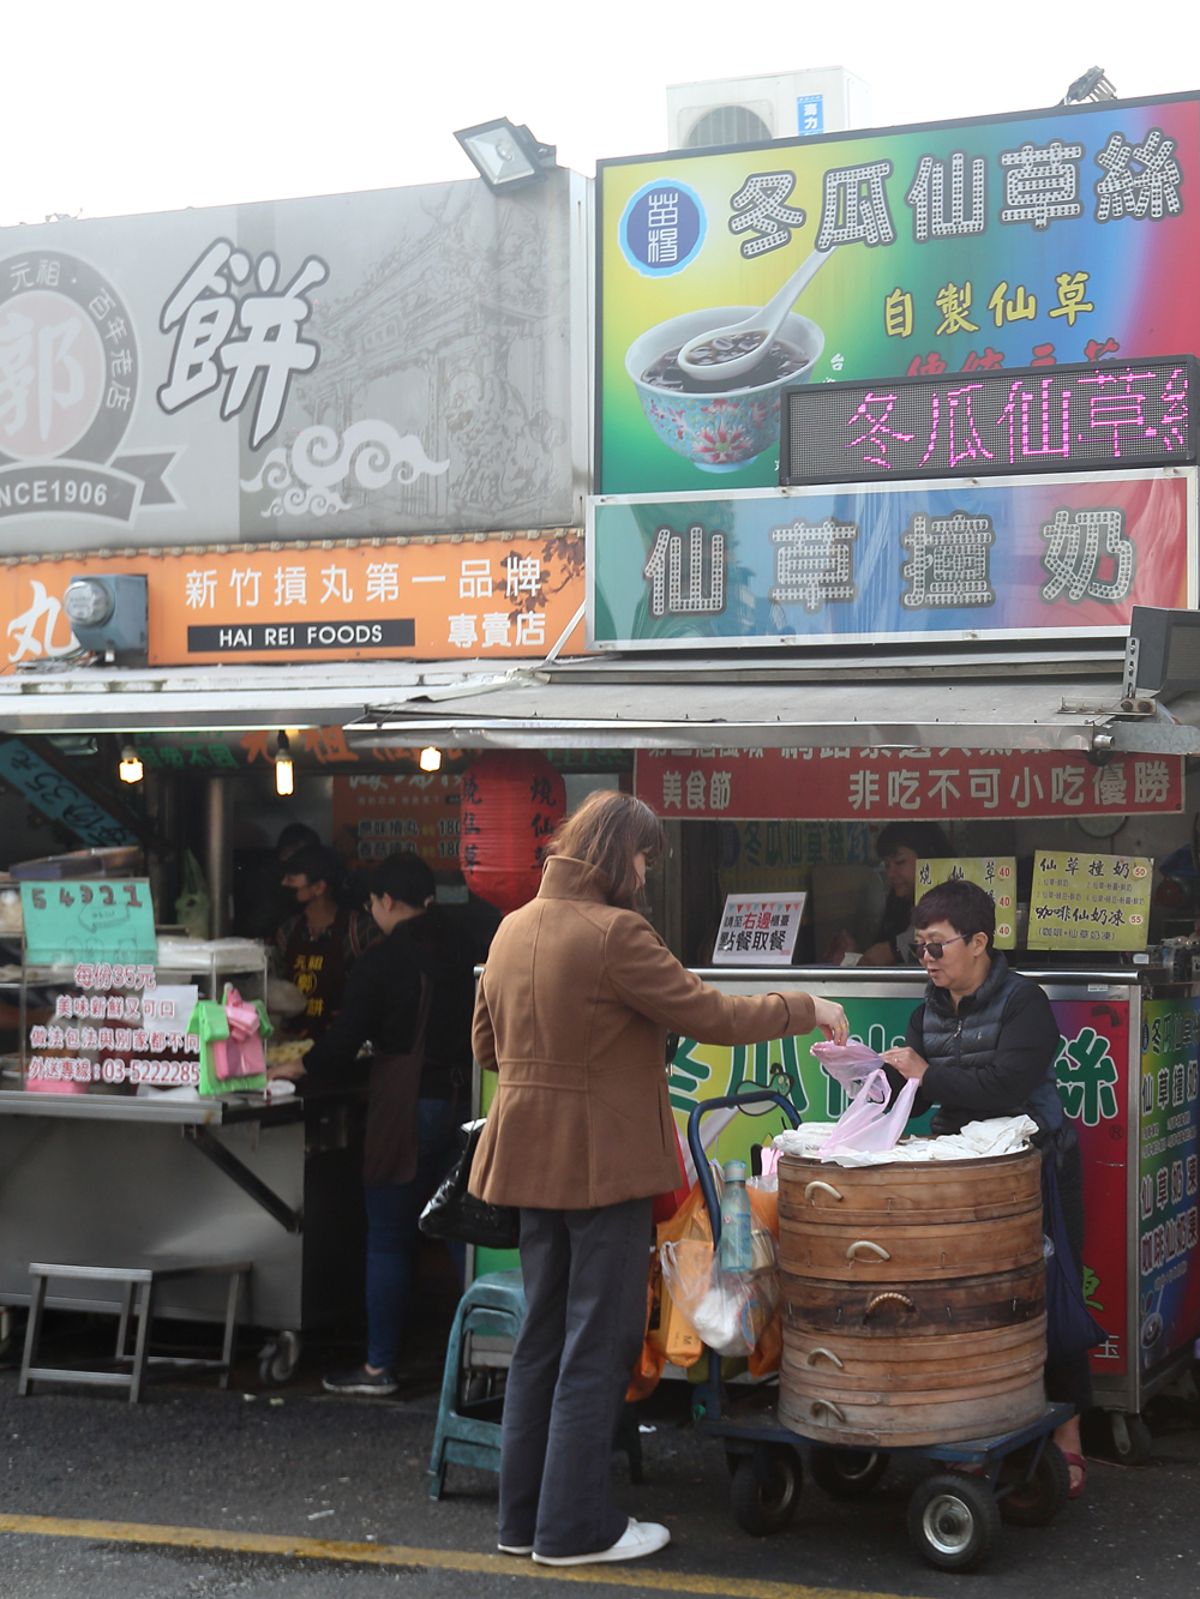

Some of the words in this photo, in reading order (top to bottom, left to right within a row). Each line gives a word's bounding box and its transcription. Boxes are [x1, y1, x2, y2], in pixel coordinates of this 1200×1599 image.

[728, 128, 1184, 260] 冬瓜仙草絲
[10, 258, 61, 292] 元祖
[883, 271, 1096, 338] 自製仙草
[88, 287, 133, 412] 百年老店
[157, 237, 329, 451] 餅
[643, 509, 1136, 618] 仙草撞奶
[219, 628, 253, 648] HAI
[265, 626, 295, 646] REI
[307, 624, 383, 645] FOODS
[447, 610, 547, 649] 專賣店
[662, 769, 732, 811] 美食節
[848, 760, 1171, 811] 非吃不可小吃優勝
[999, 867, 1010, 877] 40
[1040, 856, 1130, 879] 仙草撞奶
[1134, 867, 1146, 876] 50
[999, 897, 1010, 907] 40
[998, 926, 1010, 935] 40
[1130, 916, 1142, 924] 55
[74, 963, 157, 990] 每份35元
[56, 995, 176, 1020] 美味新鮮又可口
